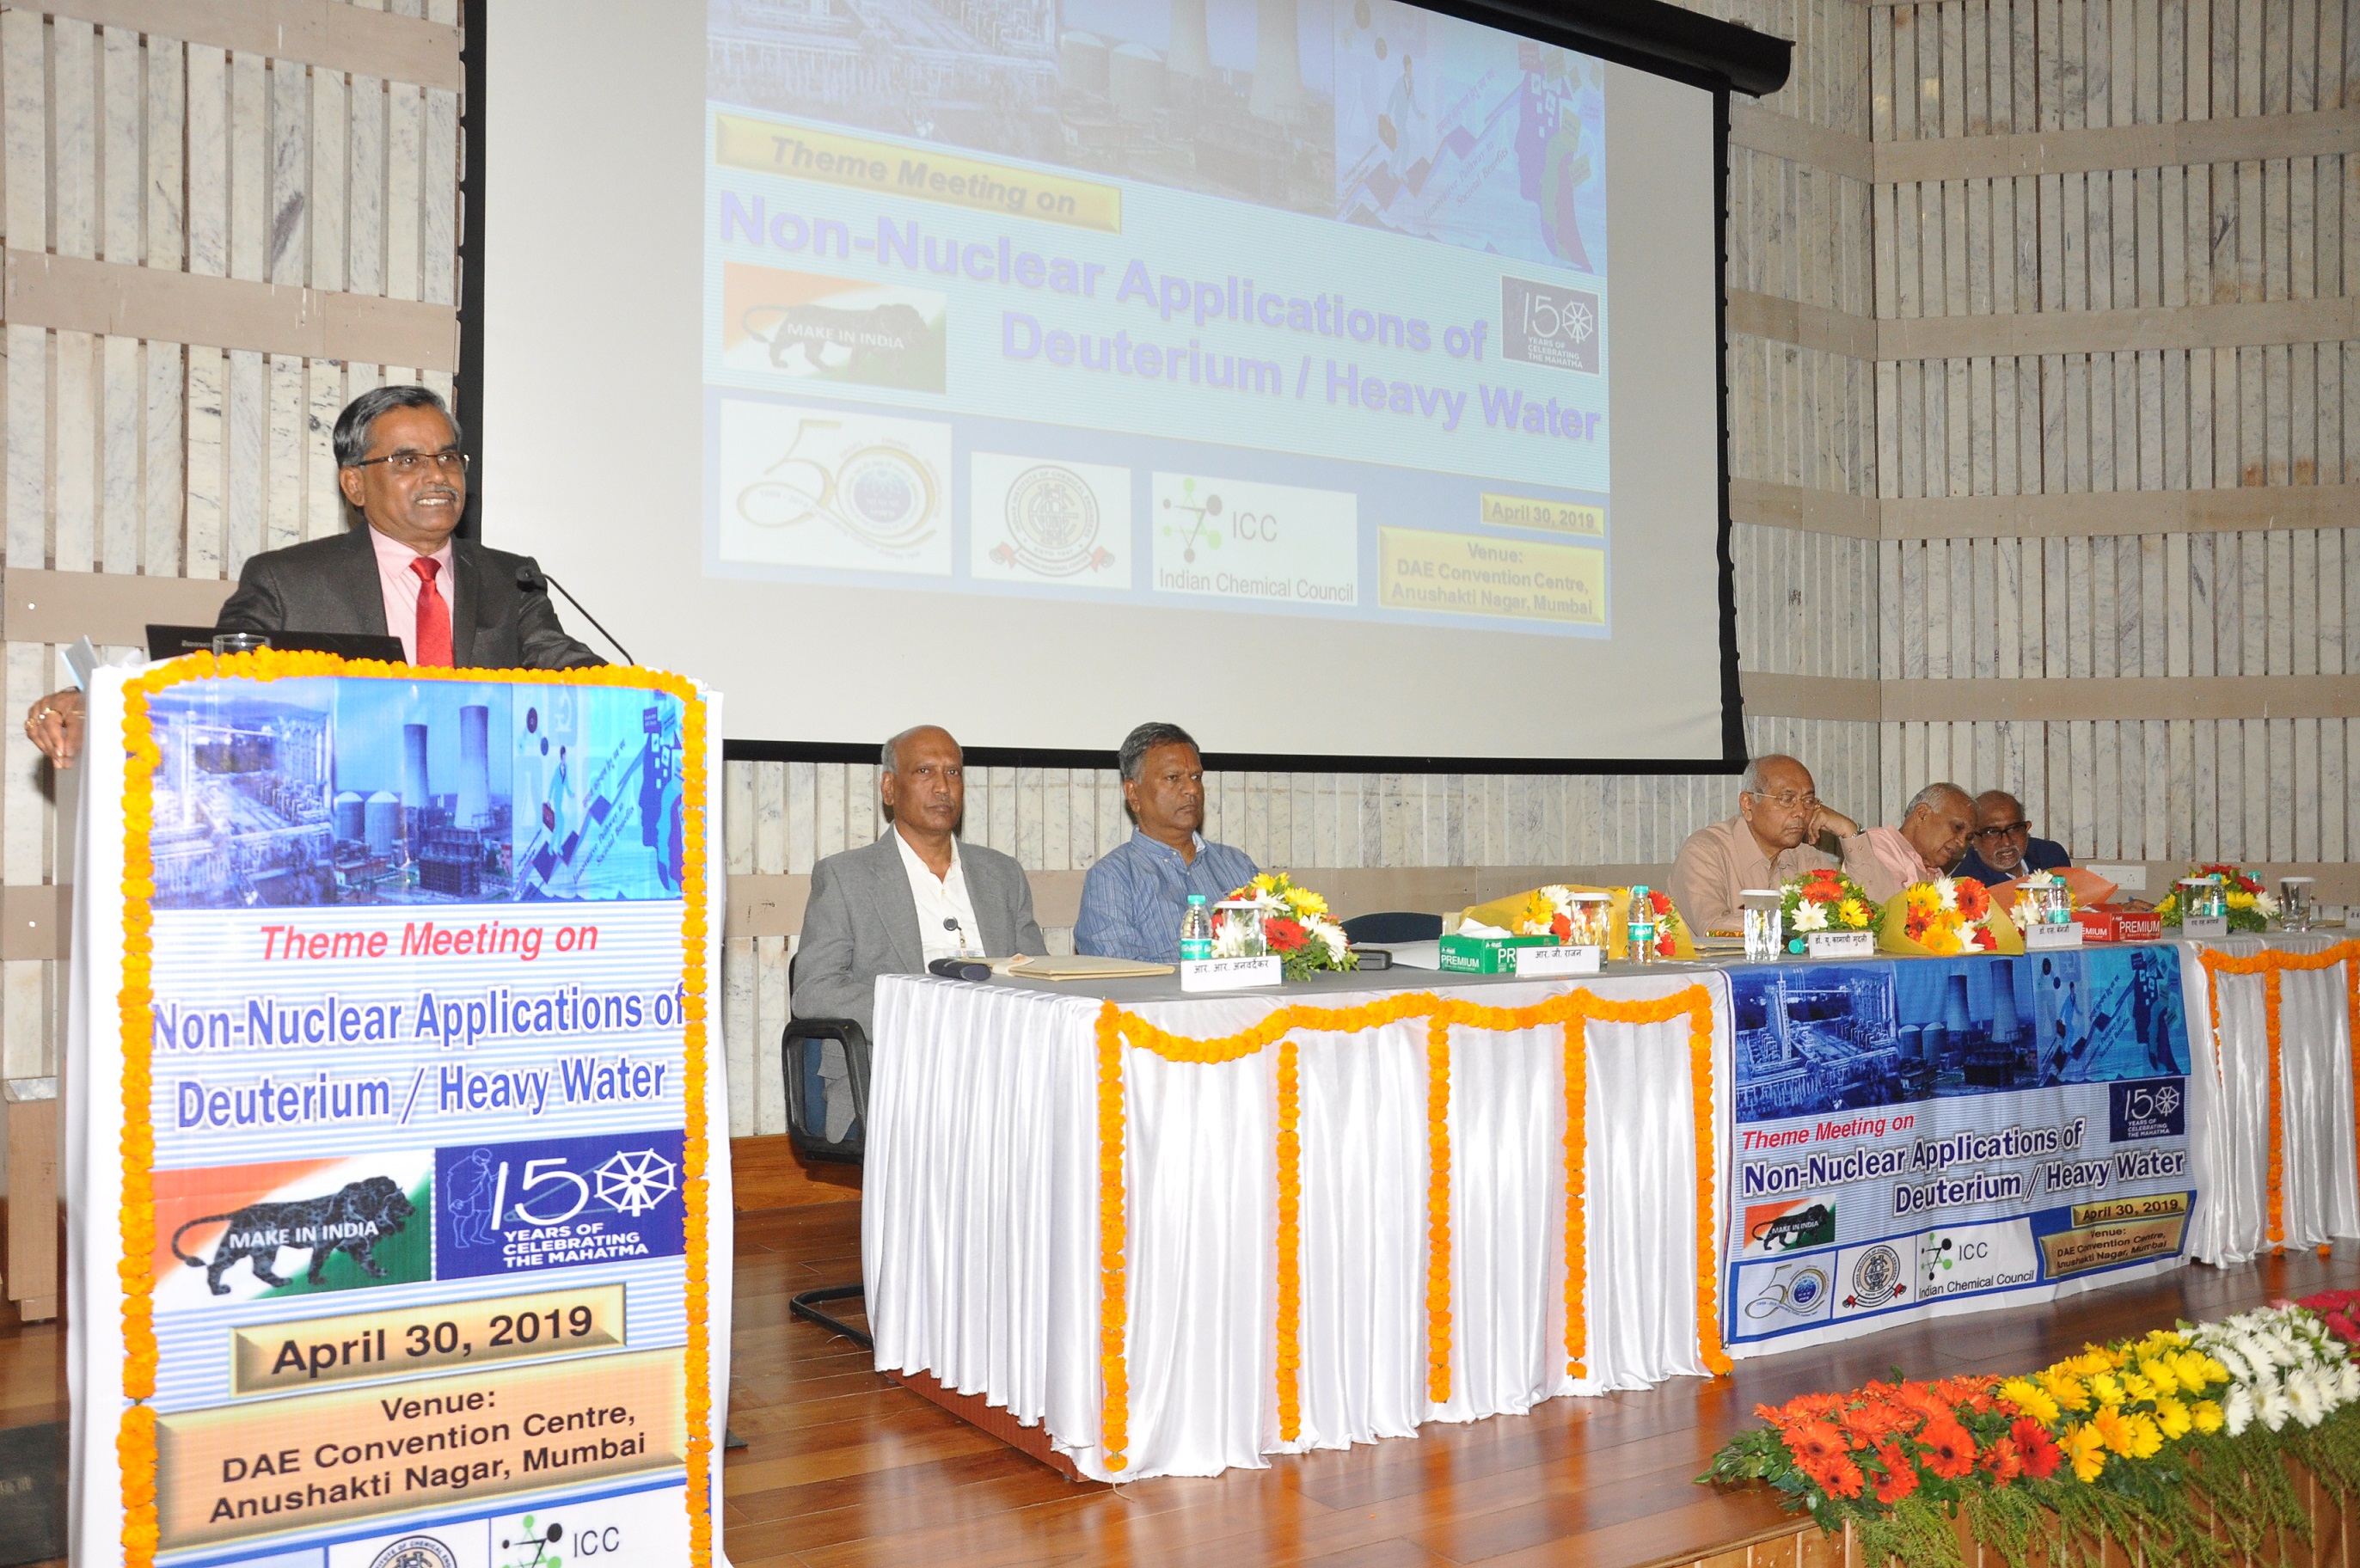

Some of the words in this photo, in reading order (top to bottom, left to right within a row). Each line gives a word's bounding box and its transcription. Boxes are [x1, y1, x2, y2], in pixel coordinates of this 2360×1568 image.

[771, 135, 887, 181] Theme
[898, 160, 1027, 215] Meeting
[1036, 191, 1076, 214] on
[719, 190, 1106, 297] Non-Nuclear
[1116, 259, 1431, 352] Applications
[1444, 320, 1488, 361] of
[787, 322, 834, 341] MAKE
[838, 327, 855, 343] IN
[860, 331, 904, 350] INDIA
[1528, 336, 1554, 347] YEARS
[1528, 345, 1579, 360] CELEBRATING
[1528, 352, 1544, 362] THE
[1002, 310, 1282, 395] Deuterium
[1296, 356, 1310, 399] /
[1326, 359, 1467, 431] Heavy
[1479, 384, 1601, 441] Water
[1232, 511, 1278, 542] ICC
[1492, 502, 1529, 523] April
[1534, 506, 1554, 526] 30,
[1560, 511, 1594, 529] 2019
[1468, 542, 1523, 564] Venue:
[1159, 567, 1211, 592] Indian
[1216, 572, 1290, 597] Chemical
[1296, 579, 1354, 603] Council
[1397, 559, 1434, 577] DAE
[1438, 563, 1531, 587] Convention
[1534, 572, 1589, 594] Centre,
[1392, 582, 1475, 605] Anushakti
[1480, 590, 1530, 613] Nagar,
[1534, 595, 1592, 616] Mumbai
[260, 924, 389, 960] Theme
[400, 921, 543, 961] Meeting
[555, 923, 598, 952] on
[2082, 928, 2107, 936] EMIUM
[2119, 921, 2161, 933] PREMIUM
[1441, 954, 1480, 968] PREMIUM
[154, 995, 402, 1047] Non-Nuclear
[415, 985, 643, 1046] Applications
[653, 986, 684, 1026] of
[178, 1075, 390, 1129] Deuterium
[398, 1066, 426, 1124] /
[439, 1065, 550, 1114] Heavy
[561, 1057, 667, 1102] Water
[1742, 1129, 1809, 1150] Theme
[1815, 1117, 1886, 1142] Meeting
[1891, 1115, 1915, 1130] on
[2128, 1123, 2167, 1131] CELEBRATING
[1745, 1148, 1906, 1194] Non-Nuclear
[1912, 1128, 2057, 1165] Applications
[2062, 1121, 2084, 1148] of
[1896, 1173, 2020, 1213] Deuterium
[2026, 1166, 2042, 1200] /
[2048, 1161, 2109, 1191] Heavy
[2117, 1151, 2184, 1180] Water
[2083, 1206, 2111, 1222] April
[2116, 1204, 2138, 1216] 30,
[2143, 1199, 2179, 1213] 2019
[229, 1228, 292, 1251] MAKE
[297, 1225, 316, 1242] IN
[322, 1220, 379, 1240] INDIA
[504, 1225, 571, 1242] YEARS
[576, 1222, 604, 1234] OF
[1772, 1225, 1791, 1234] MAKE
[1801, 1220, 1819, 1229] INDIA
[2091, 1228, 2126, 1238] Venue:
[503, 1232, 640, 1255] CELEBRATING
[503, 1253, 543, 1268] THE
[549, 1243, 649, 1265] MAHATMA
[1958, 1241, 1988, 1261] ICC
[2057, 1247, 2075, 1258] DAE
[2078, 1240, 2130, 1253] Convention
[2133, 1232, 2166, 1243] Centre,
[2097, 1249, 2128, 1260] Nagar,
[1919, 1282, 1945, 1299] Indian
[1946, 1277, 1993, 1294] Chemical
[1996, 1269, 2034, 1286] Council
[273, 1328, 387, 1378] April
[406, 1322, 471, 1358] 30,
[489, 1306, 593, 1346] 2019
[382, 1390, 496, 1421] Venue:
[224, 1449, 301, 1483] DAE
[314, 1423, 510, 1469] Convention
[524, 1401, 636, 1437] Centre,
[210, 1474, 392, 1523] Anushakti
[407, 1458, 512, 1497] Nagar,
[524, 1433, 645, 1472] Mumbai
[573, 1526, 620, 1558] ICC
